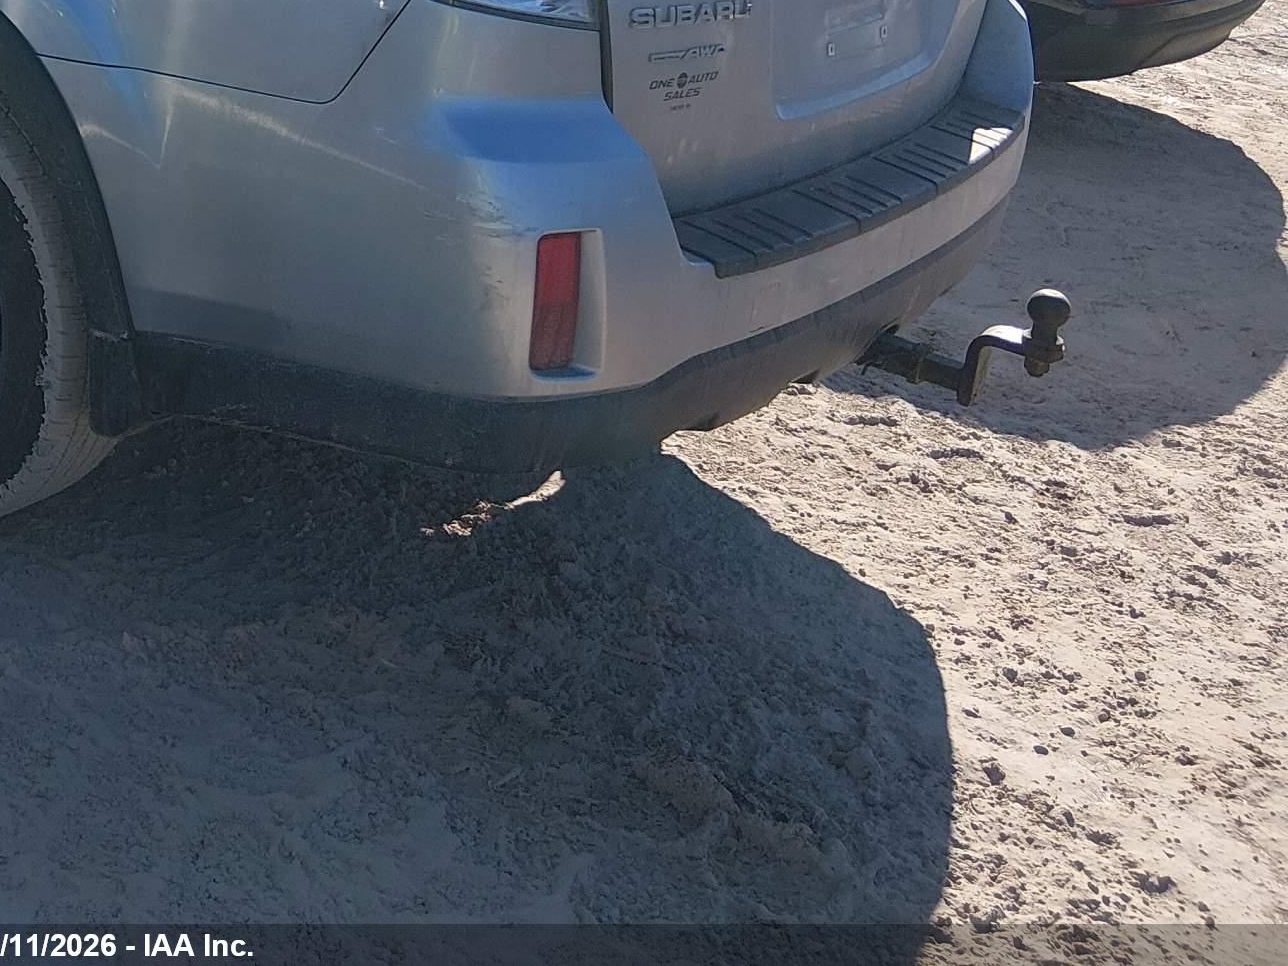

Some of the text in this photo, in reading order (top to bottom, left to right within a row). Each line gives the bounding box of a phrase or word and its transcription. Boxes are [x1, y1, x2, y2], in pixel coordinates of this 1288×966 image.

[649, 70, 720, 91] ONE AUTO
[663, 87, 702, 102] SALES
